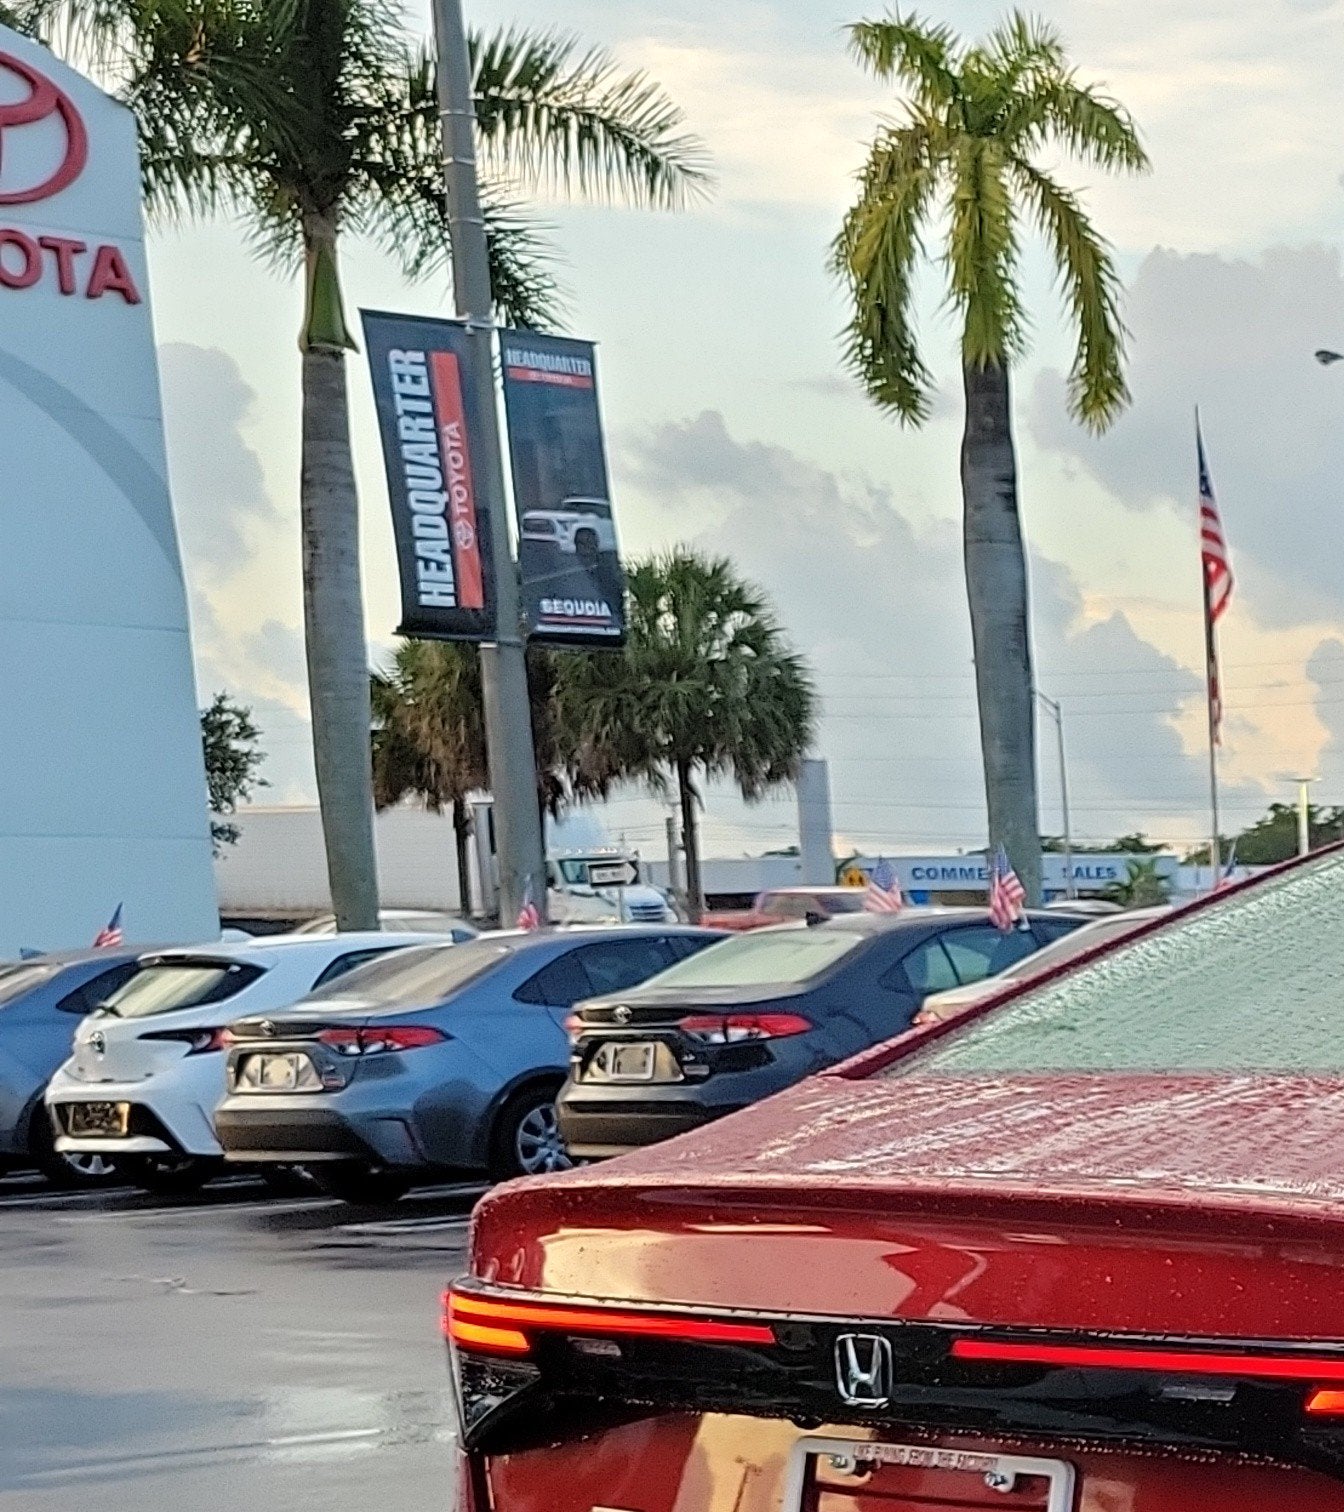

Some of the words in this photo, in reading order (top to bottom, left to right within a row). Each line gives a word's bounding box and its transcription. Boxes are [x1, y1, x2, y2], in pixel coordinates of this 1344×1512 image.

[388, 348, 457, 608] HEADQUARTER
[441, 421, 469, 514] TOYOTA
[541, 598, 612, 617] SEQUOIA
